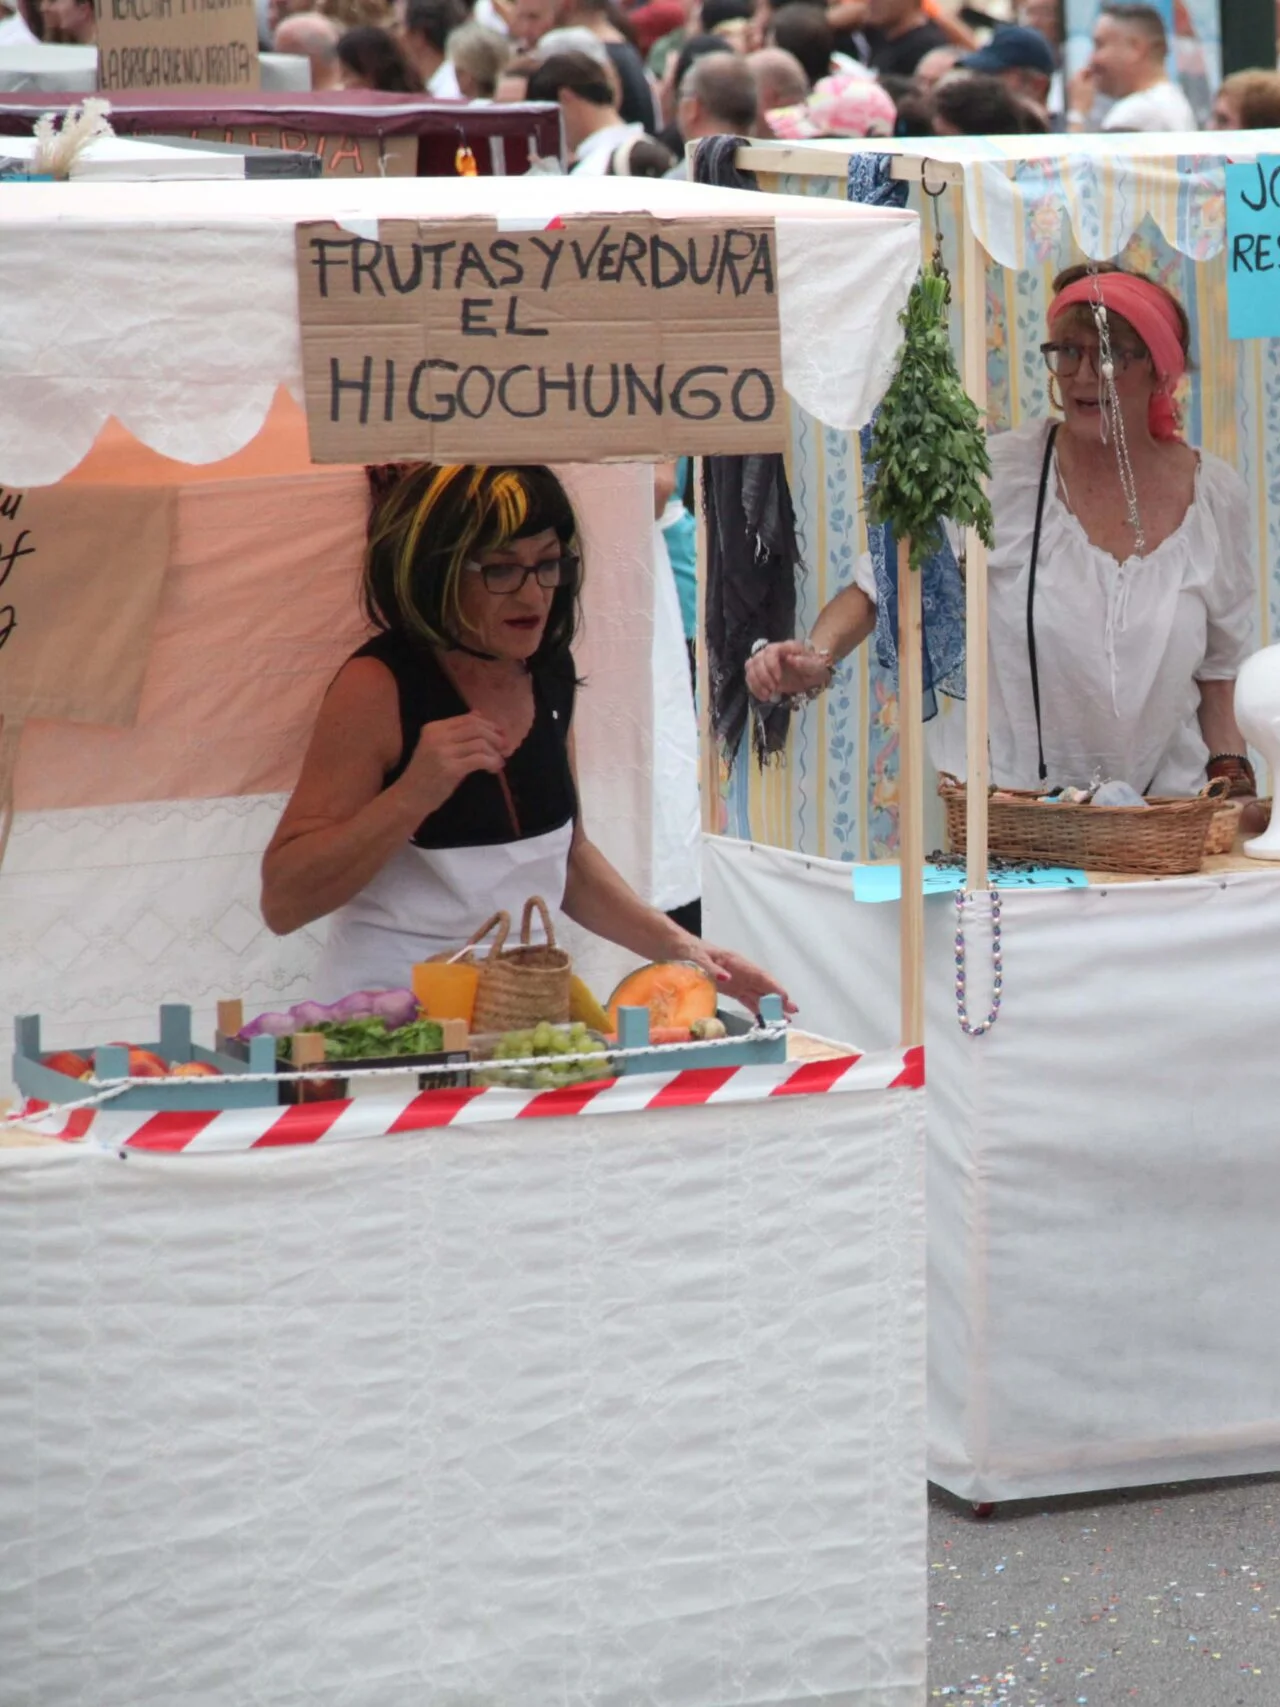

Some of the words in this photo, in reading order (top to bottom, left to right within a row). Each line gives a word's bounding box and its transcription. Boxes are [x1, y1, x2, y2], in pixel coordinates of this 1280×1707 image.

[310, 236, 525, 297] FRUTAS
[529, 235, 564, 291] Y
[570, 226, 775, 297] VERDURA
[461, 296, 549, 337] EL
[329, 355, 776, 424] HIGOCHUNGO
